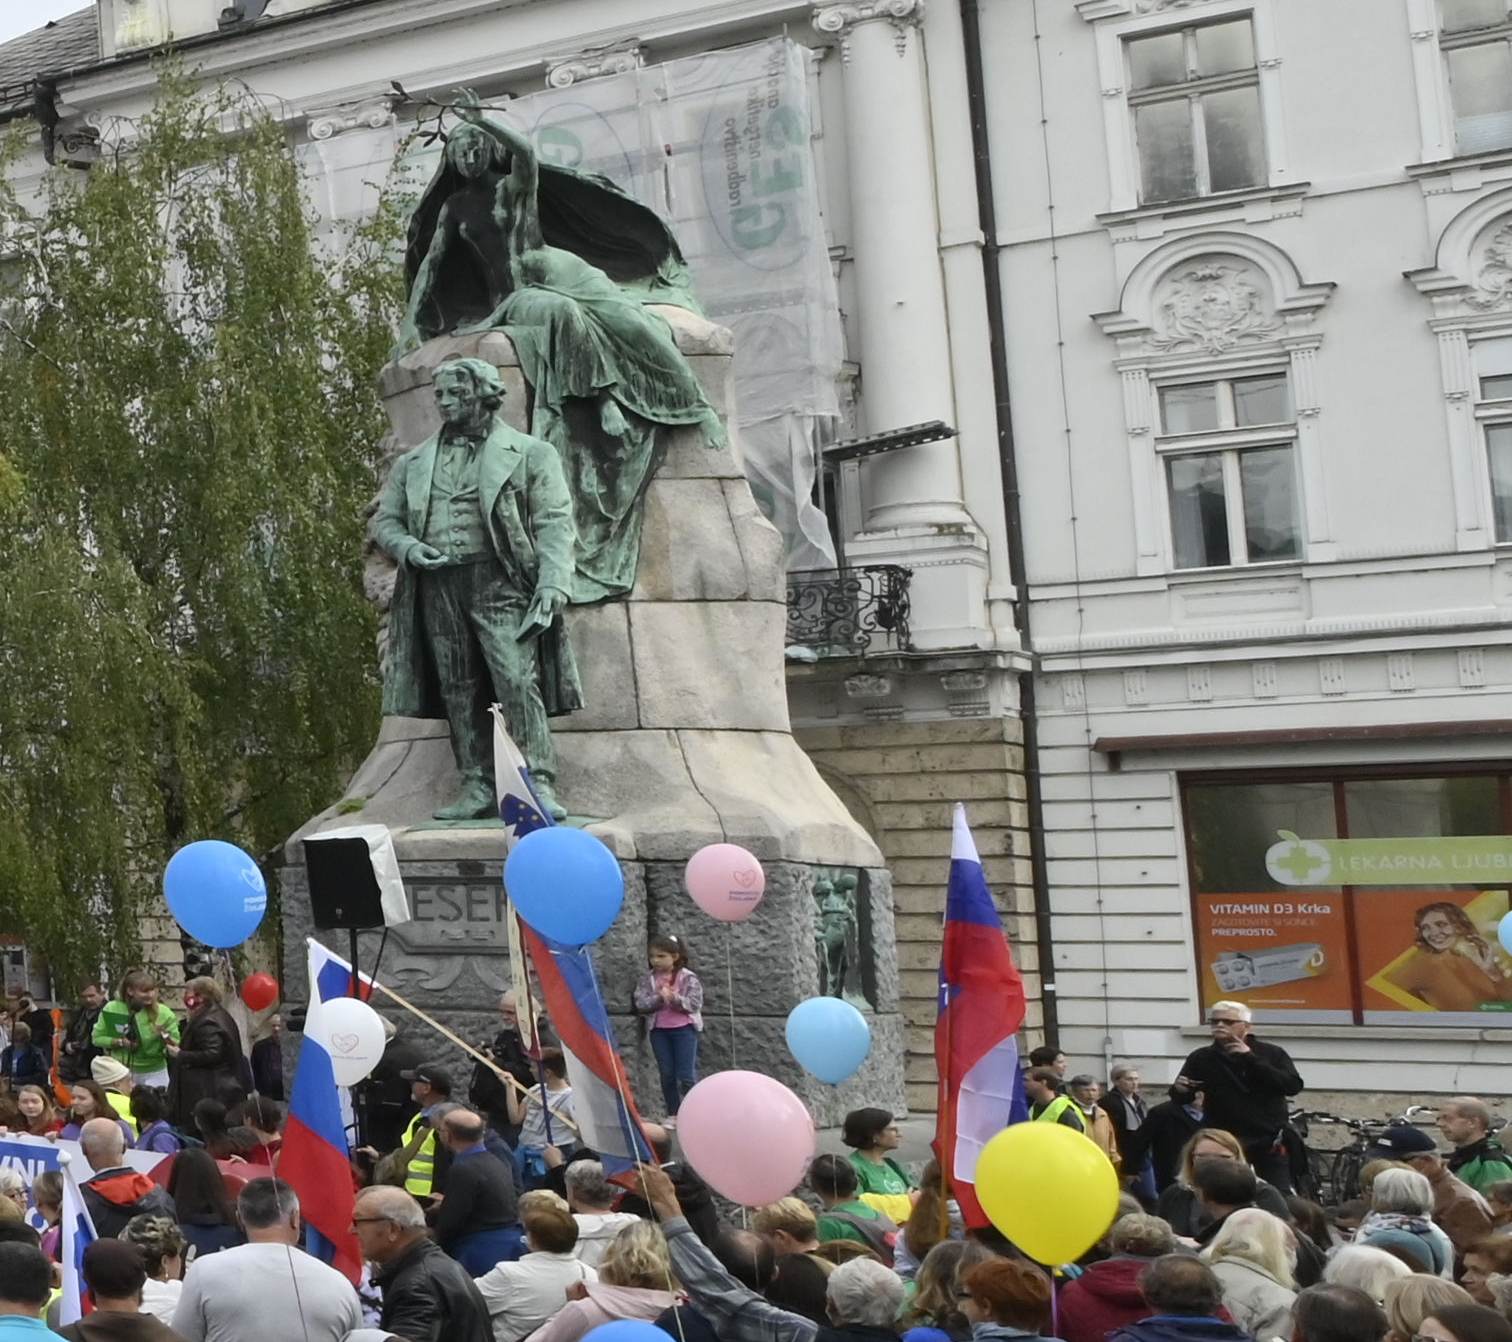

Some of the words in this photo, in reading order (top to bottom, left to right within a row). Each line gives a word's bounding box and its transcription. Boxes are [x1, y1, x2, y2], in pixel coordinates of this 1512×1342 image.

[1339, 856, 1443, 870] LEKARNA
[1452, 855, 1512, 869] LJUB
[414, 886, 507, 922] ESE
[1210, 904, 1270, 915] VITAMIN
[1274, 904, 1294, 914] D3
[1298, 903, 1332, 915] Krka
[1211, 928, 1278, 937] PREPROSTO.
